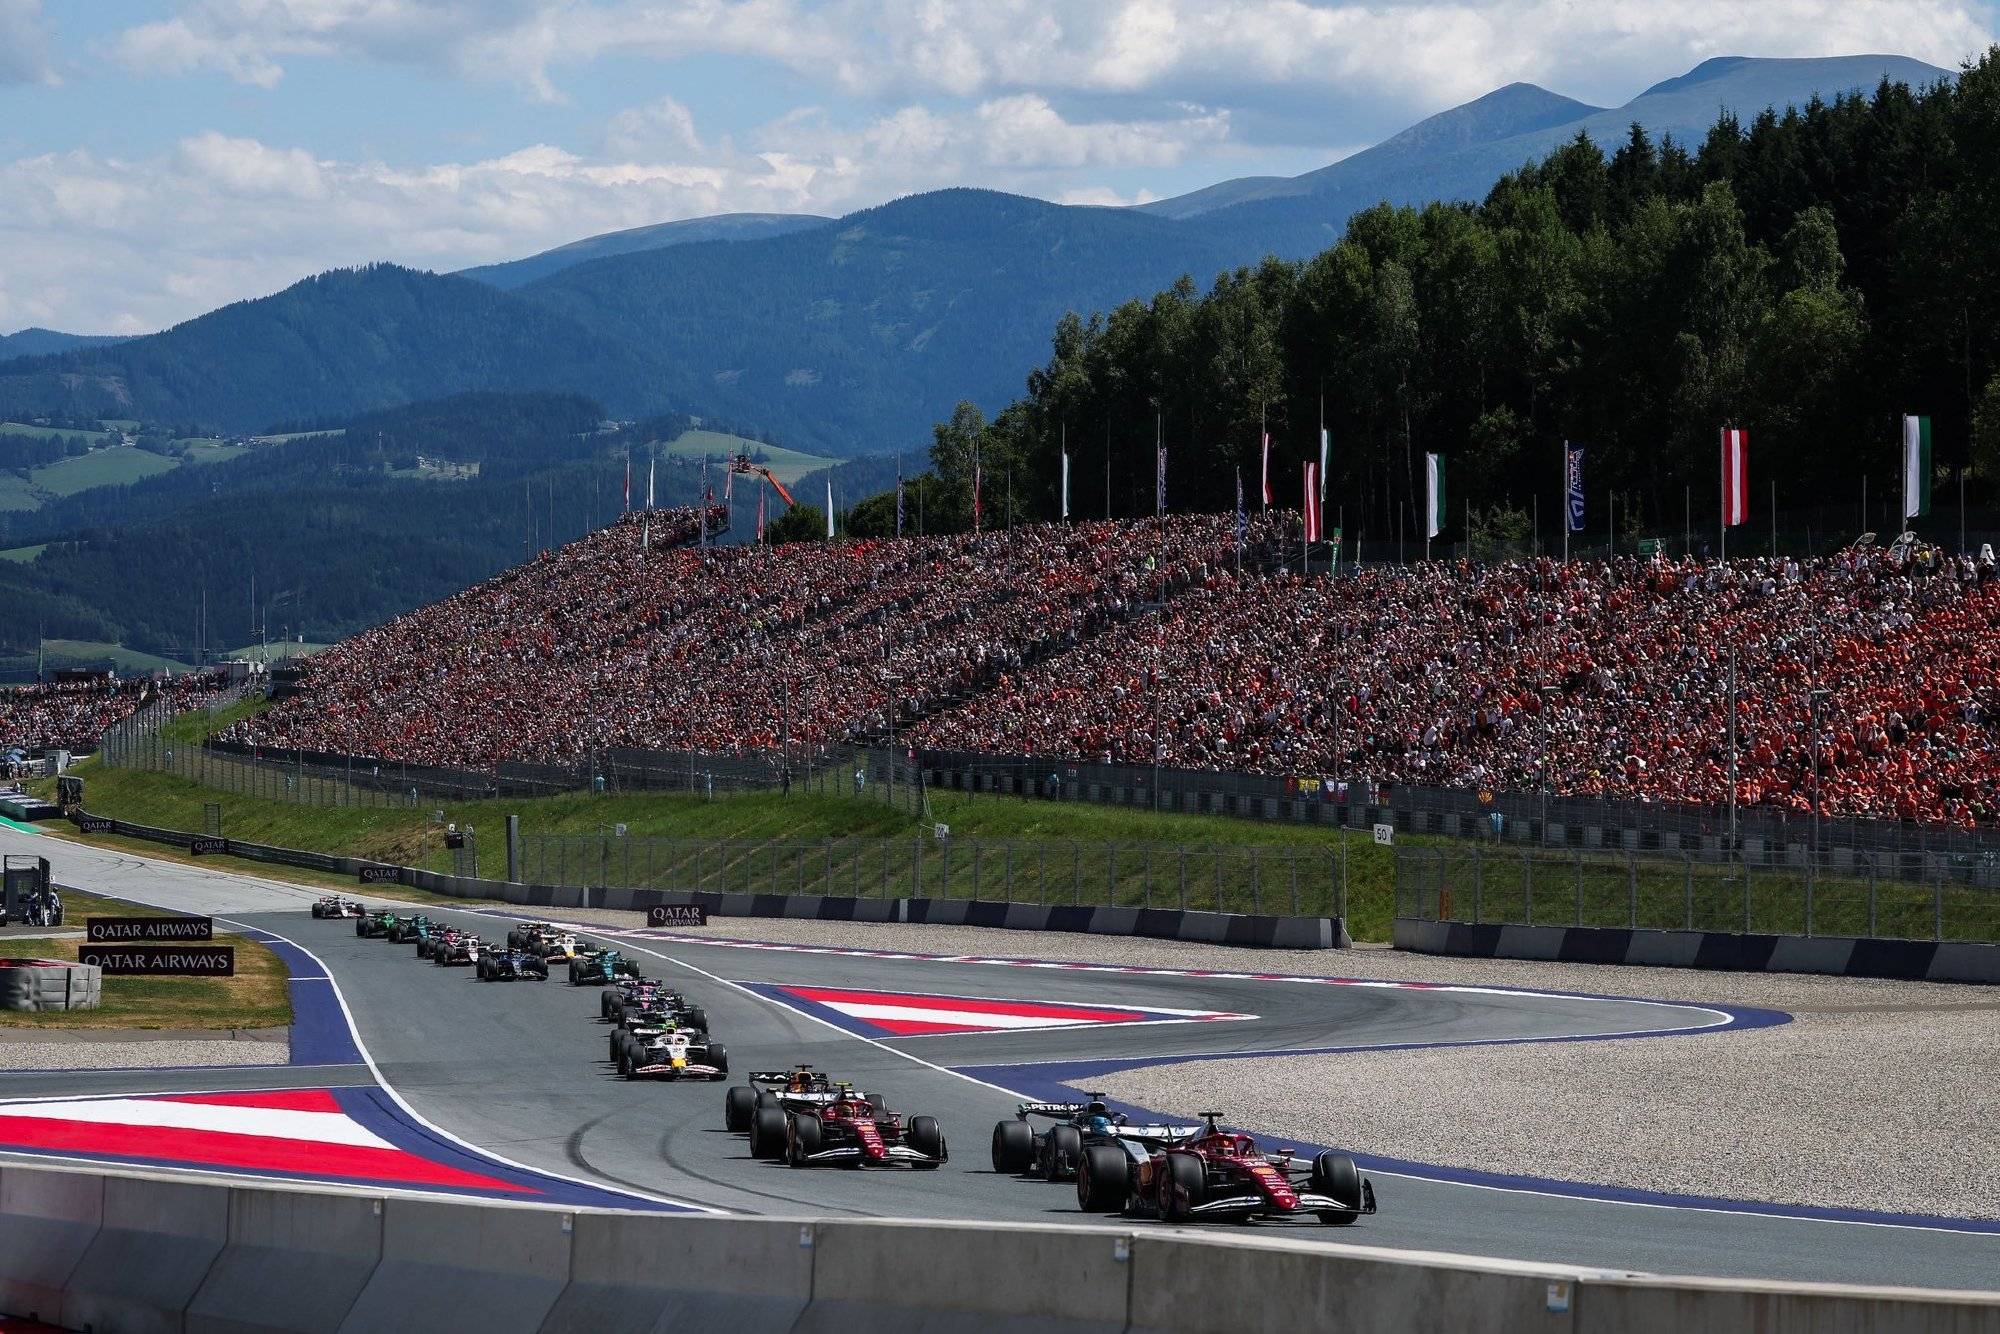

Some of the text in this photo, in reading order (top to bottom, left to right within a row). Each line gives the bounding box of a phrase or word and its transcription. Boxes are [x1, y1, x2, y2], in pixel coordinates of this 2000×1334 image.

[83, 821, 111, 830] QATAR
[1376, 828, 1387, 840] 50
[195, 841, 225, 851] QATAR
[363, 869, 398, 879] QATAR
[653, 907, 700, 920] QATAR
[92, 923, 208, 939] QATAR AIRWAYS
[85, 954, 228, 969] QATAR AIRWAYS
